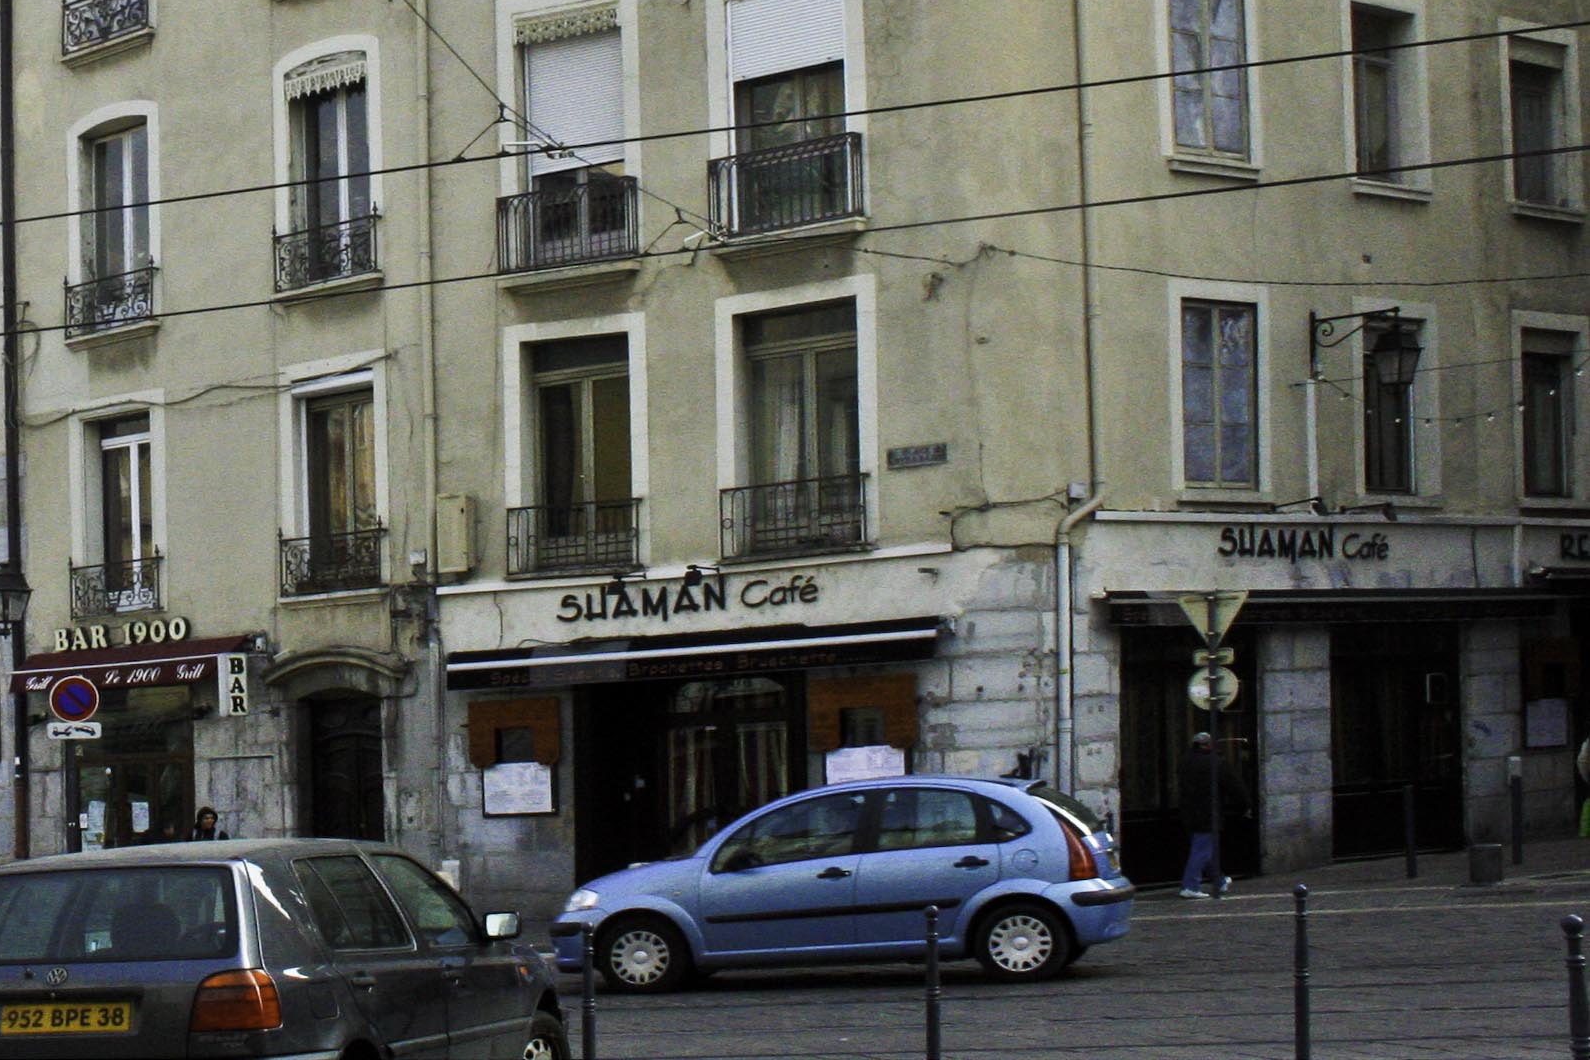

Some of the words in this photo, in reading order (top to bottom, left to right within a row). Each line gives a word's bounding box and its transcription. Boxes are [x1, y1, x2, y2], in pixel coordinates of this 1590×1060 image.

[1342, 533, 1389, 559] Café
[740, 575, 819, 608] Café
[54, 624, 107, 651] BAR
[121, 617, 187, 645] 1900
[126, 668, 160, 683] 1900
[176, 663, 206, 680] Grill
[229, 657, 246, 713] BAR
[7, 1010, 44, 1028] 952
[50, 1008, 92, 1027] BPE
[97, 1007, 124, 1026] 38
